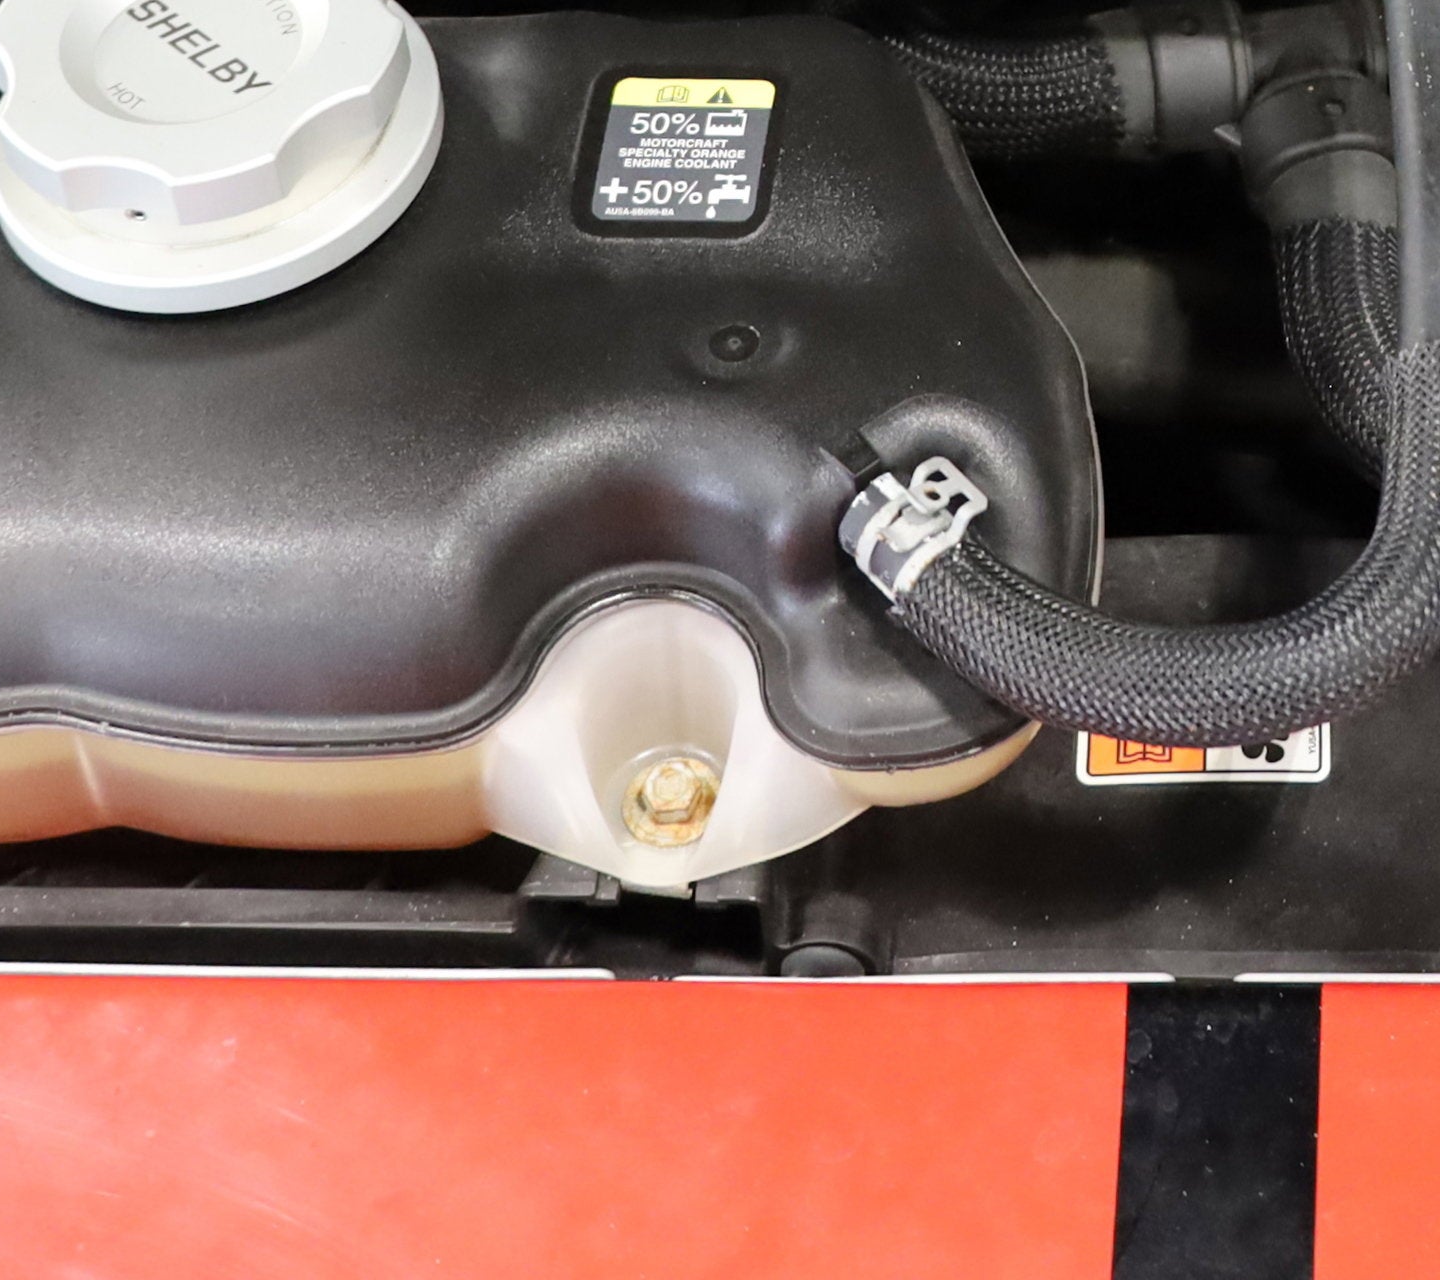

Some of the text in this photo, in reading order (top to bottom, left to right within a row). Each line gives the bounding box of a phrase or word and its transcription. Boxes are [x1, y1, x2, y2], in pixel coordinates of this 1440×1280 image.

[108, 82, 147, 111] HOT
[630, 112, 701, 135] 50%
[640, 139, 728, 148] MOTORCRAFT
[618, 148, 746, 159] SPECIALTY ORANGE
[623, 159, 738, 169] ENGINE COOLANT
